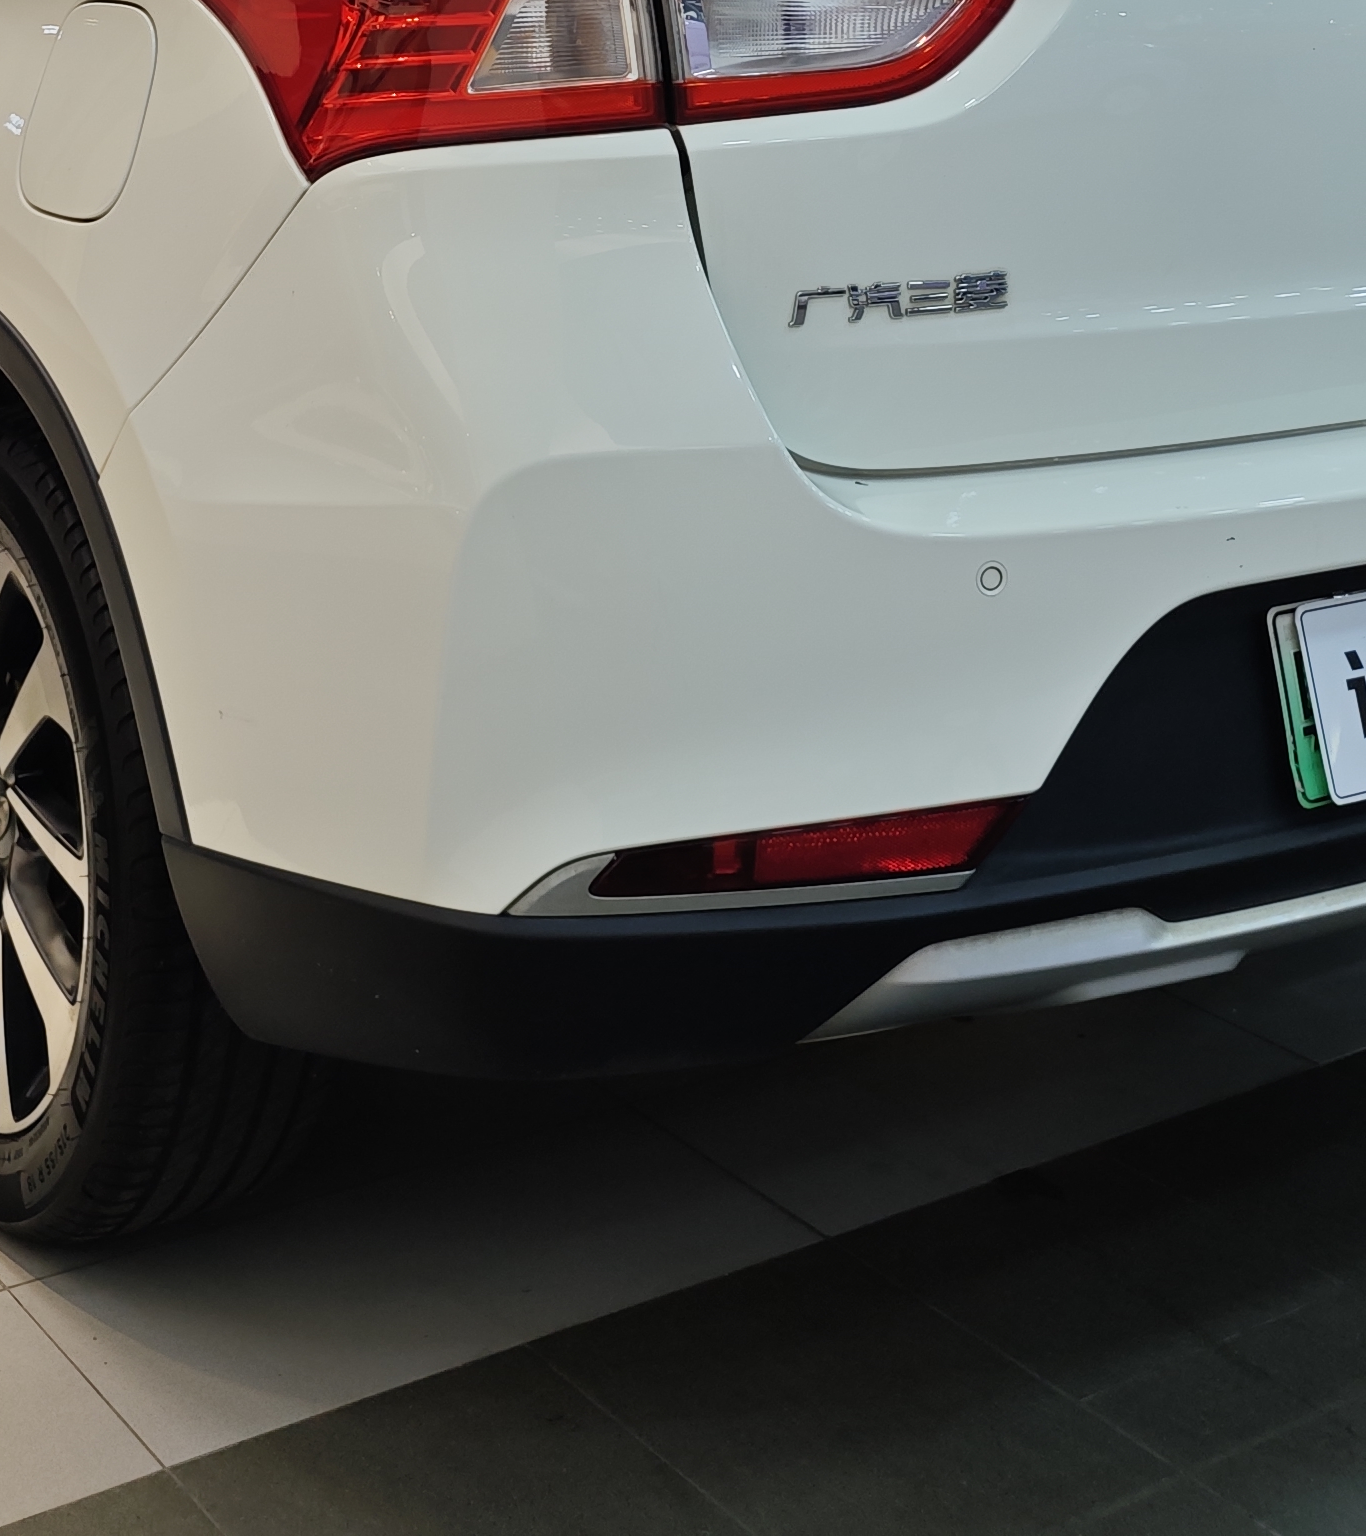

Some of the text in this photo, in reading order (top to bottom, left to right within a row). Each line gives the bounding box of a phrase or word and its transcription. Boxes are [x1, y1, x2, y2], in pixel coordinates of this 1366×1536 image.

[788, 269, 1009, 328] 广汽三菱
[76, 831, 110, 1114] MICHELIN
